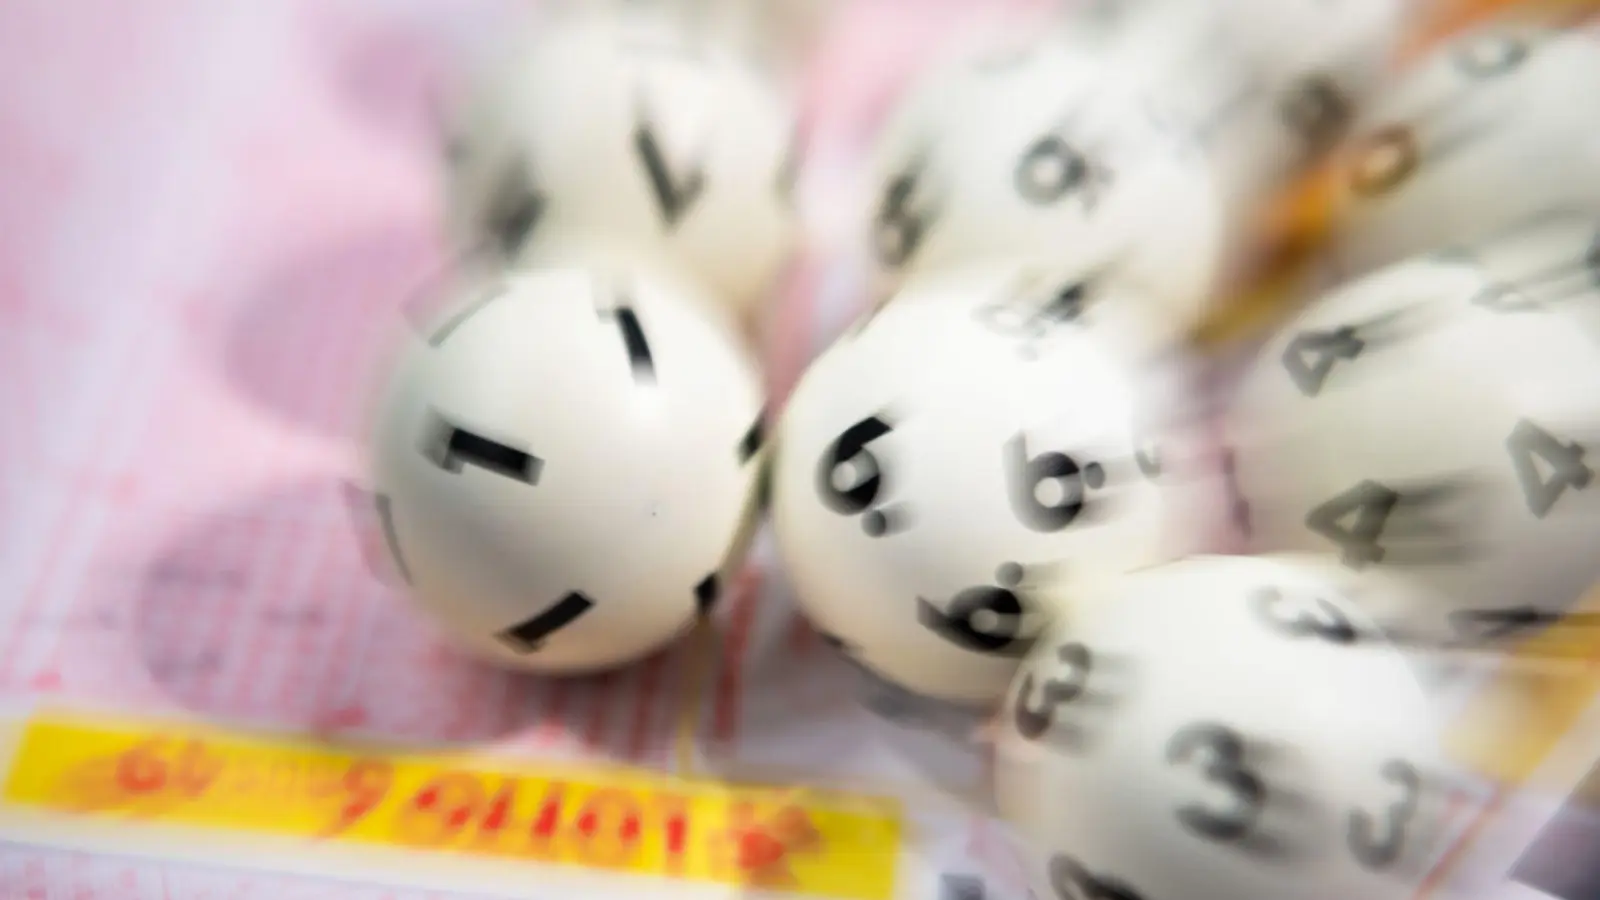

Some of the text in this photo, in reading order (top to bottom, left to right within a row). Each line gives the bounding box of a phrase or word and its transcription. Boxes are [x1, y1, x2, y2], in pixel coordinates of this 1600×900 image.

[1282, 326, 1365, 398] 4
[420, 412, 545, 486] 1
[1506, 418, 1594, 520] 4
[496, 590, 597, 655] 1
[1165, 722, 1268, 842] 3
